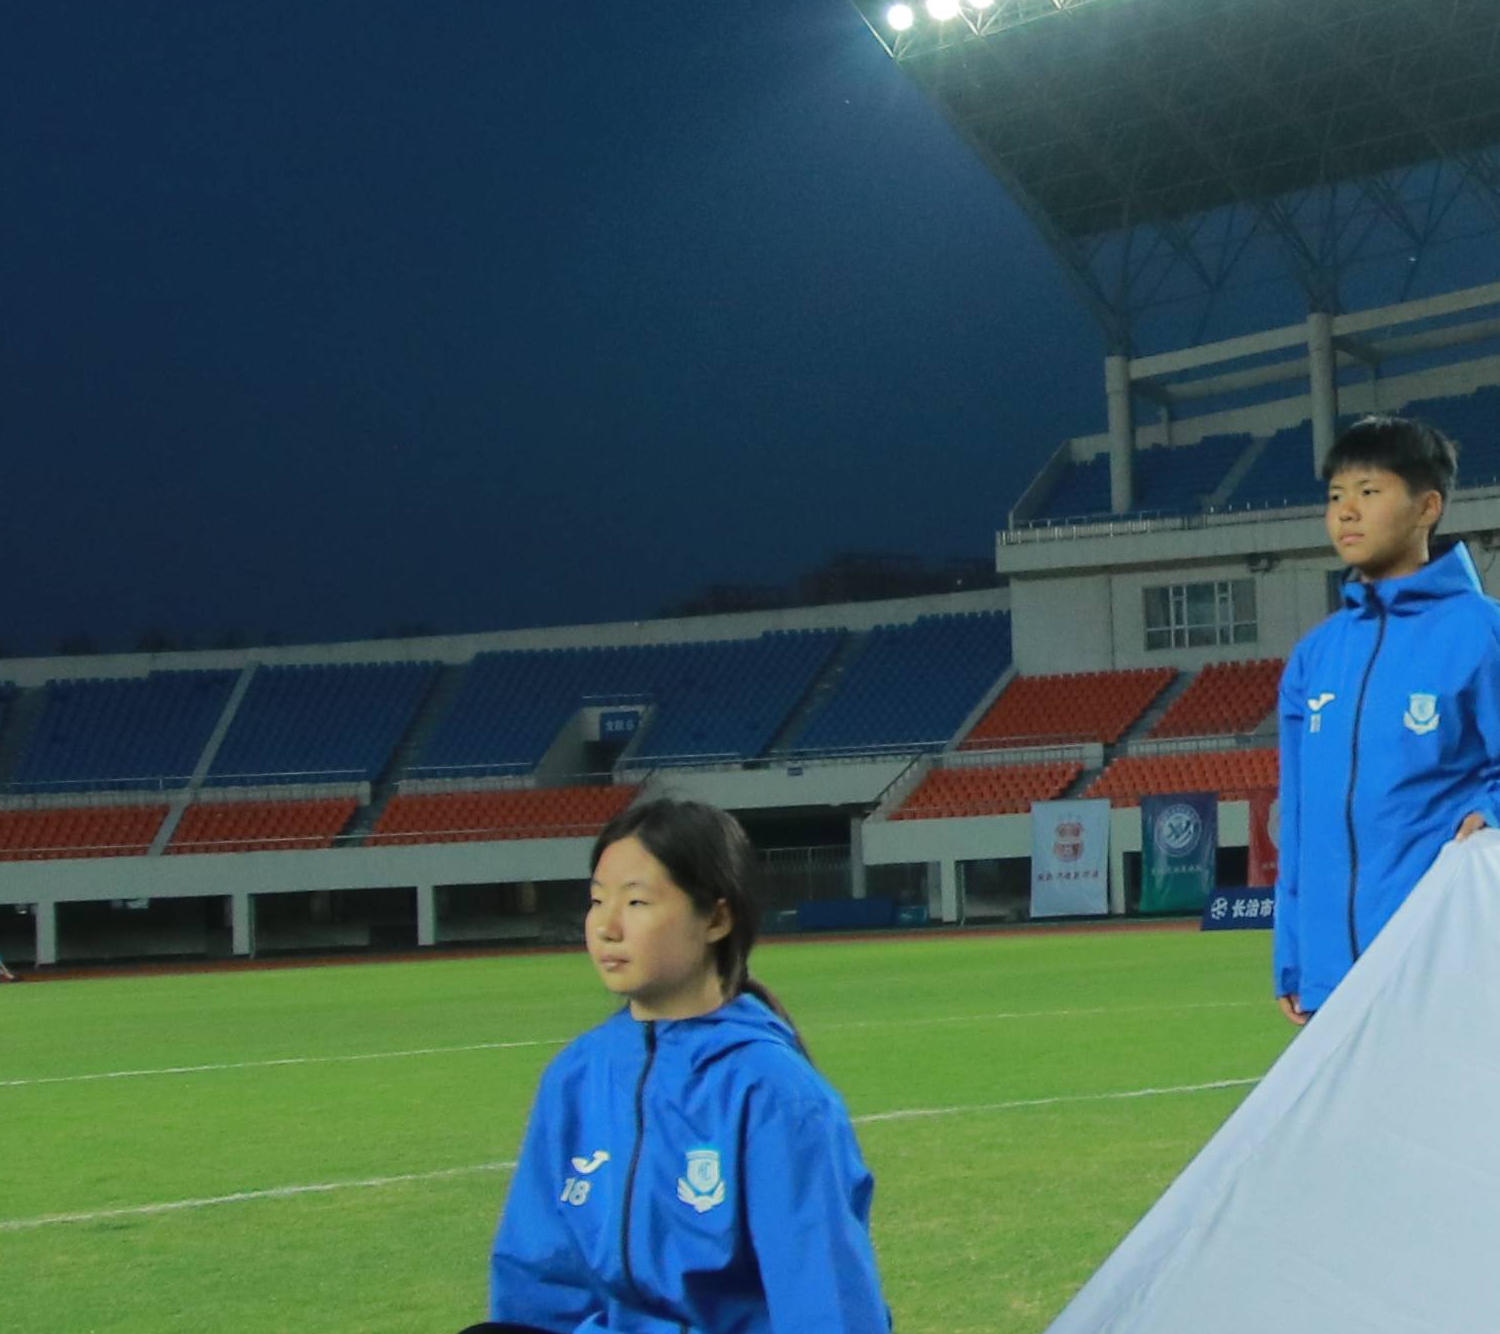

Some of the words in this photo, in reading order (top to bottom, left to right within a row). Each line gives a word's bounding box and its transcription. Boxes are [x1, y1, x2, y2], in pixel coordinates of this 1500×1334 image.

[1232, 898, 1275, 919] 长治市
[559, 1177, 591, 1206] 18
